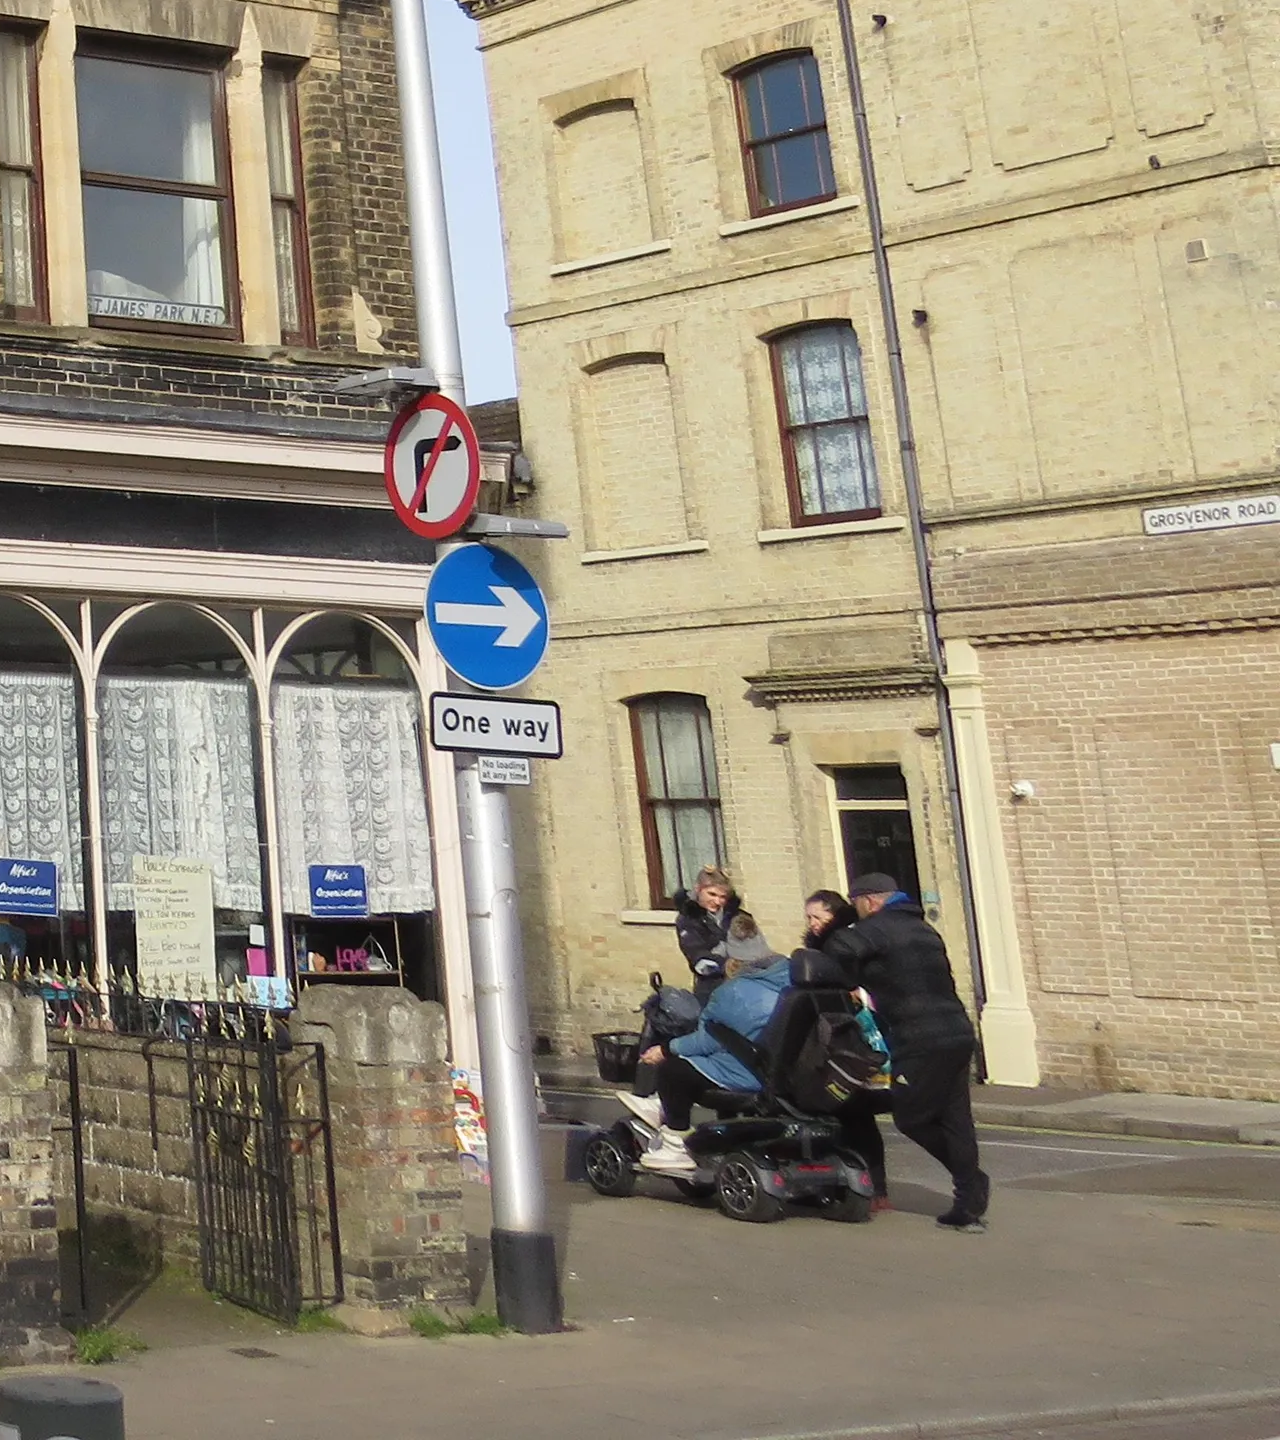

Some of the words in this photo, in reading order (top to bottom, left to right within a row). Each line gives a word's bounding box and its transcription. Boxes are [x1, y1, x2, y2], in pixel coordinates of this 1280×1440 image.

[154, 304, 185, 321] PARK
[191, 309, 219, 325] N.E.1
[1149, 507, 1231, 528] GROSVENOR
[1237, 501, 1277, 518] ROAD
[442, 707, 491, 734] One
[502, 718, 549, 742] way
[482, 759, 494, 769] No
[496, 761, 526, 771] loading
[482, 771, 492, 779] at
[493, 772, 507, 781] any
[509, 772, 527, 780] time
[9, 863, 38, 878] Alfie's
[315, 886, 363, 898] Organisation
